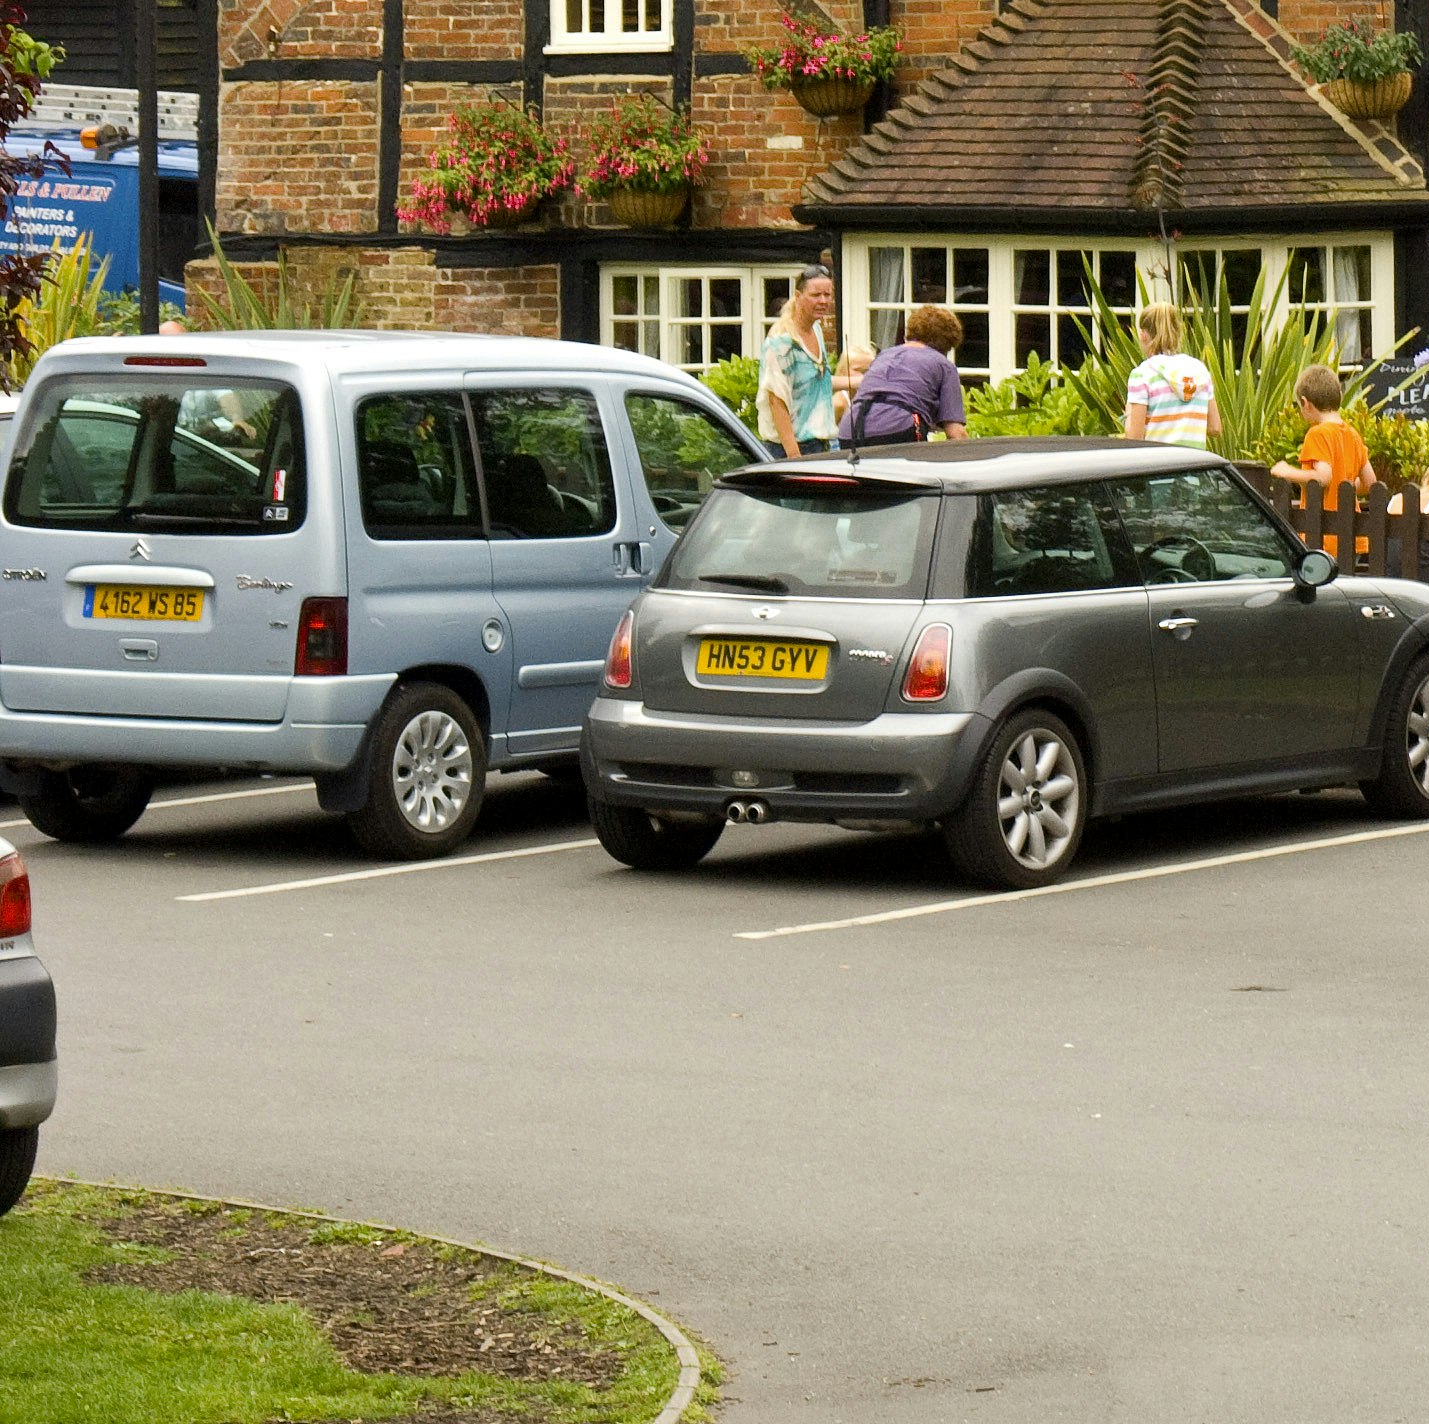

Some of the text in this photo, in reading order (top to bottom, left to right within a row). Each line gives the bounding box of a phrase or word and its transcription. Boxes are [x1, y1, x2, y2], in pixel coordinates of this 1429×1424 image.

[50, 182, 113, 203] PULLEN
[65, 209, 75, 223] &
[100, 590, 198, 617] 4162 WS 85
[707, 643, 819, 674] HN53 GYV
